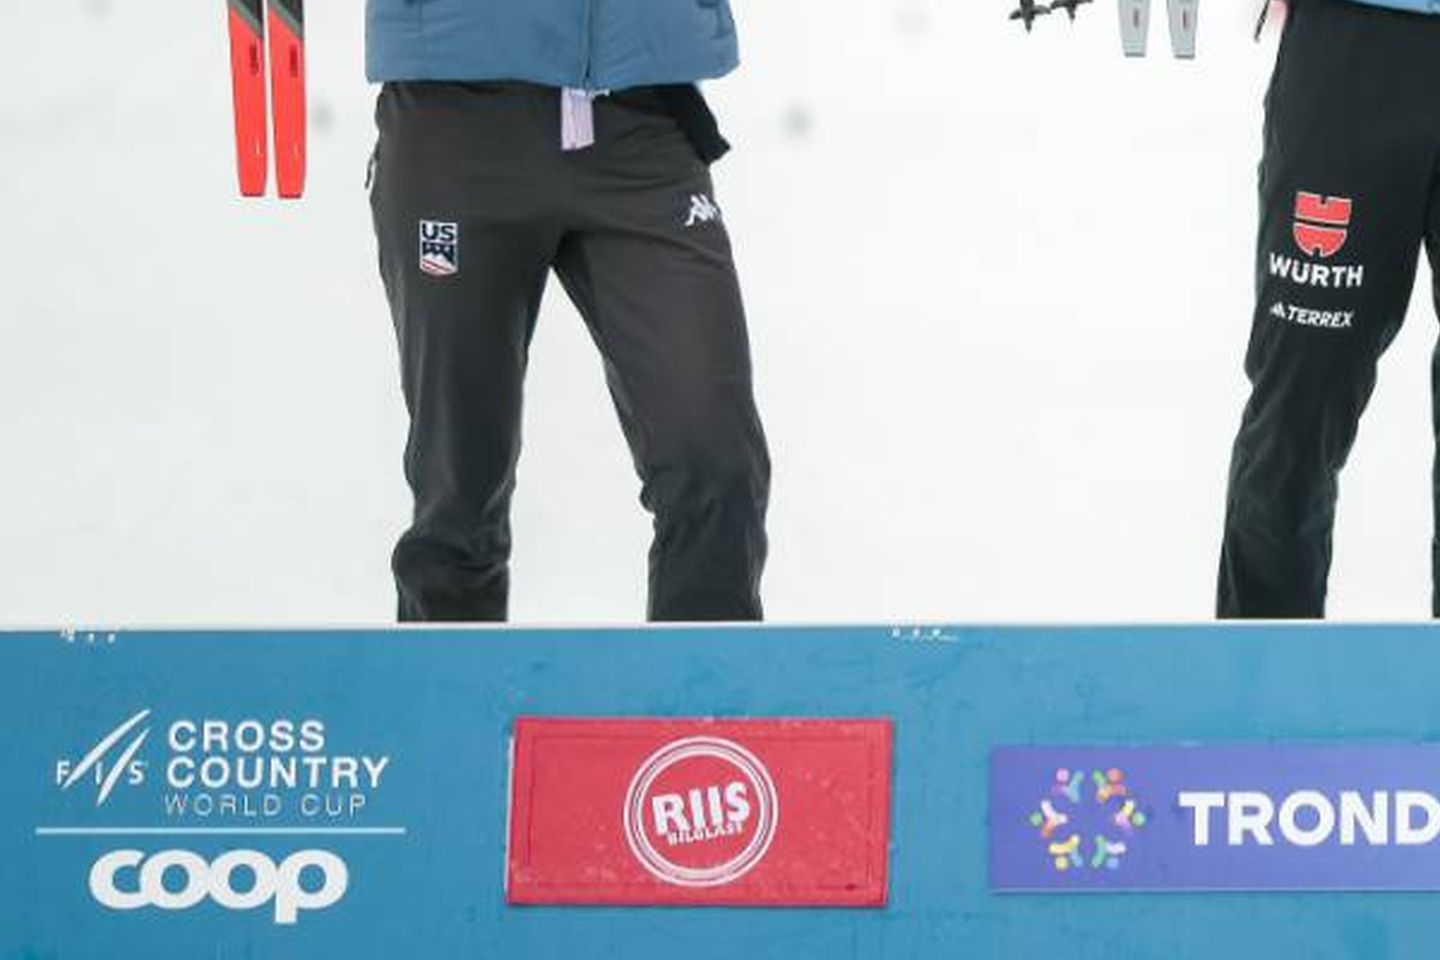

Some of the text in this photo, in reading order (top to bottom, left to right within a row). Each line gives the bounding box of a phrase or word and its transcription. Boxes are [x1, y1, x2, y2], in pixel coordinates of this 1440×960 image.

[421, 223, 455, 240] US
[1287, 304, 1355, 329] TERREX
[168, 719, 326, 753] CROSS
[166, 755, 390, 789] COUNTRY
[163, 794, 366, 818] WORLD CUP
[652, 780, 750, 836] RIIS
[88, 848, 349, 925] coop
